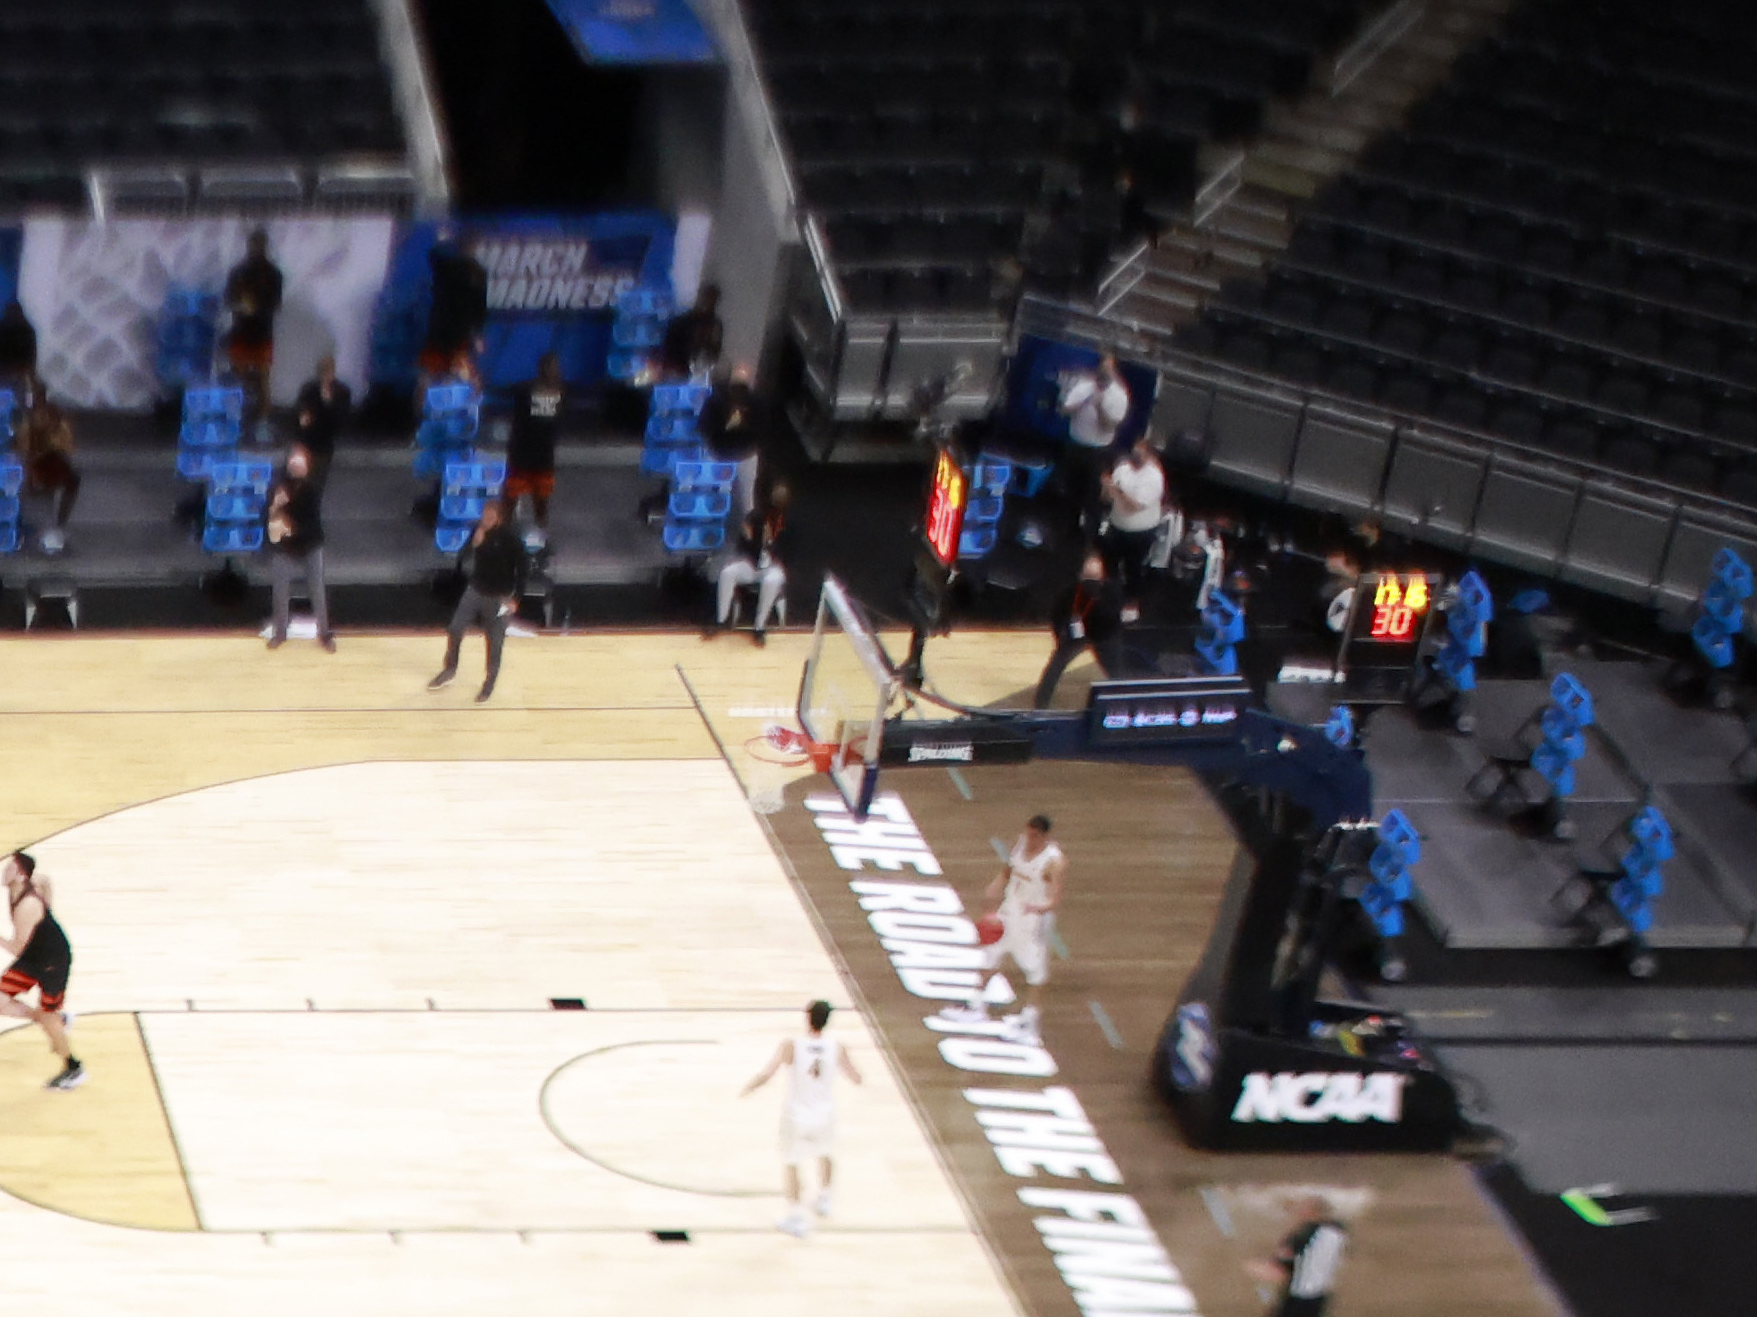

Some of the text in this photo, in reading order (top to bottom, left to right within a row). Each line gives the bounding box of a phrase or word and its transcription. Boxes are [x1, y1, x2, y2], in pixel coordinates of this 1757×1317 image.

[474, 242, 587, 276] MARCH
[1371, 607, 1415, 636] 30
[803, 792, 944, 875] THE
[962, 1085, 1126, 1184] THE
[1231, 1072, 1407, 1123] NCAA
